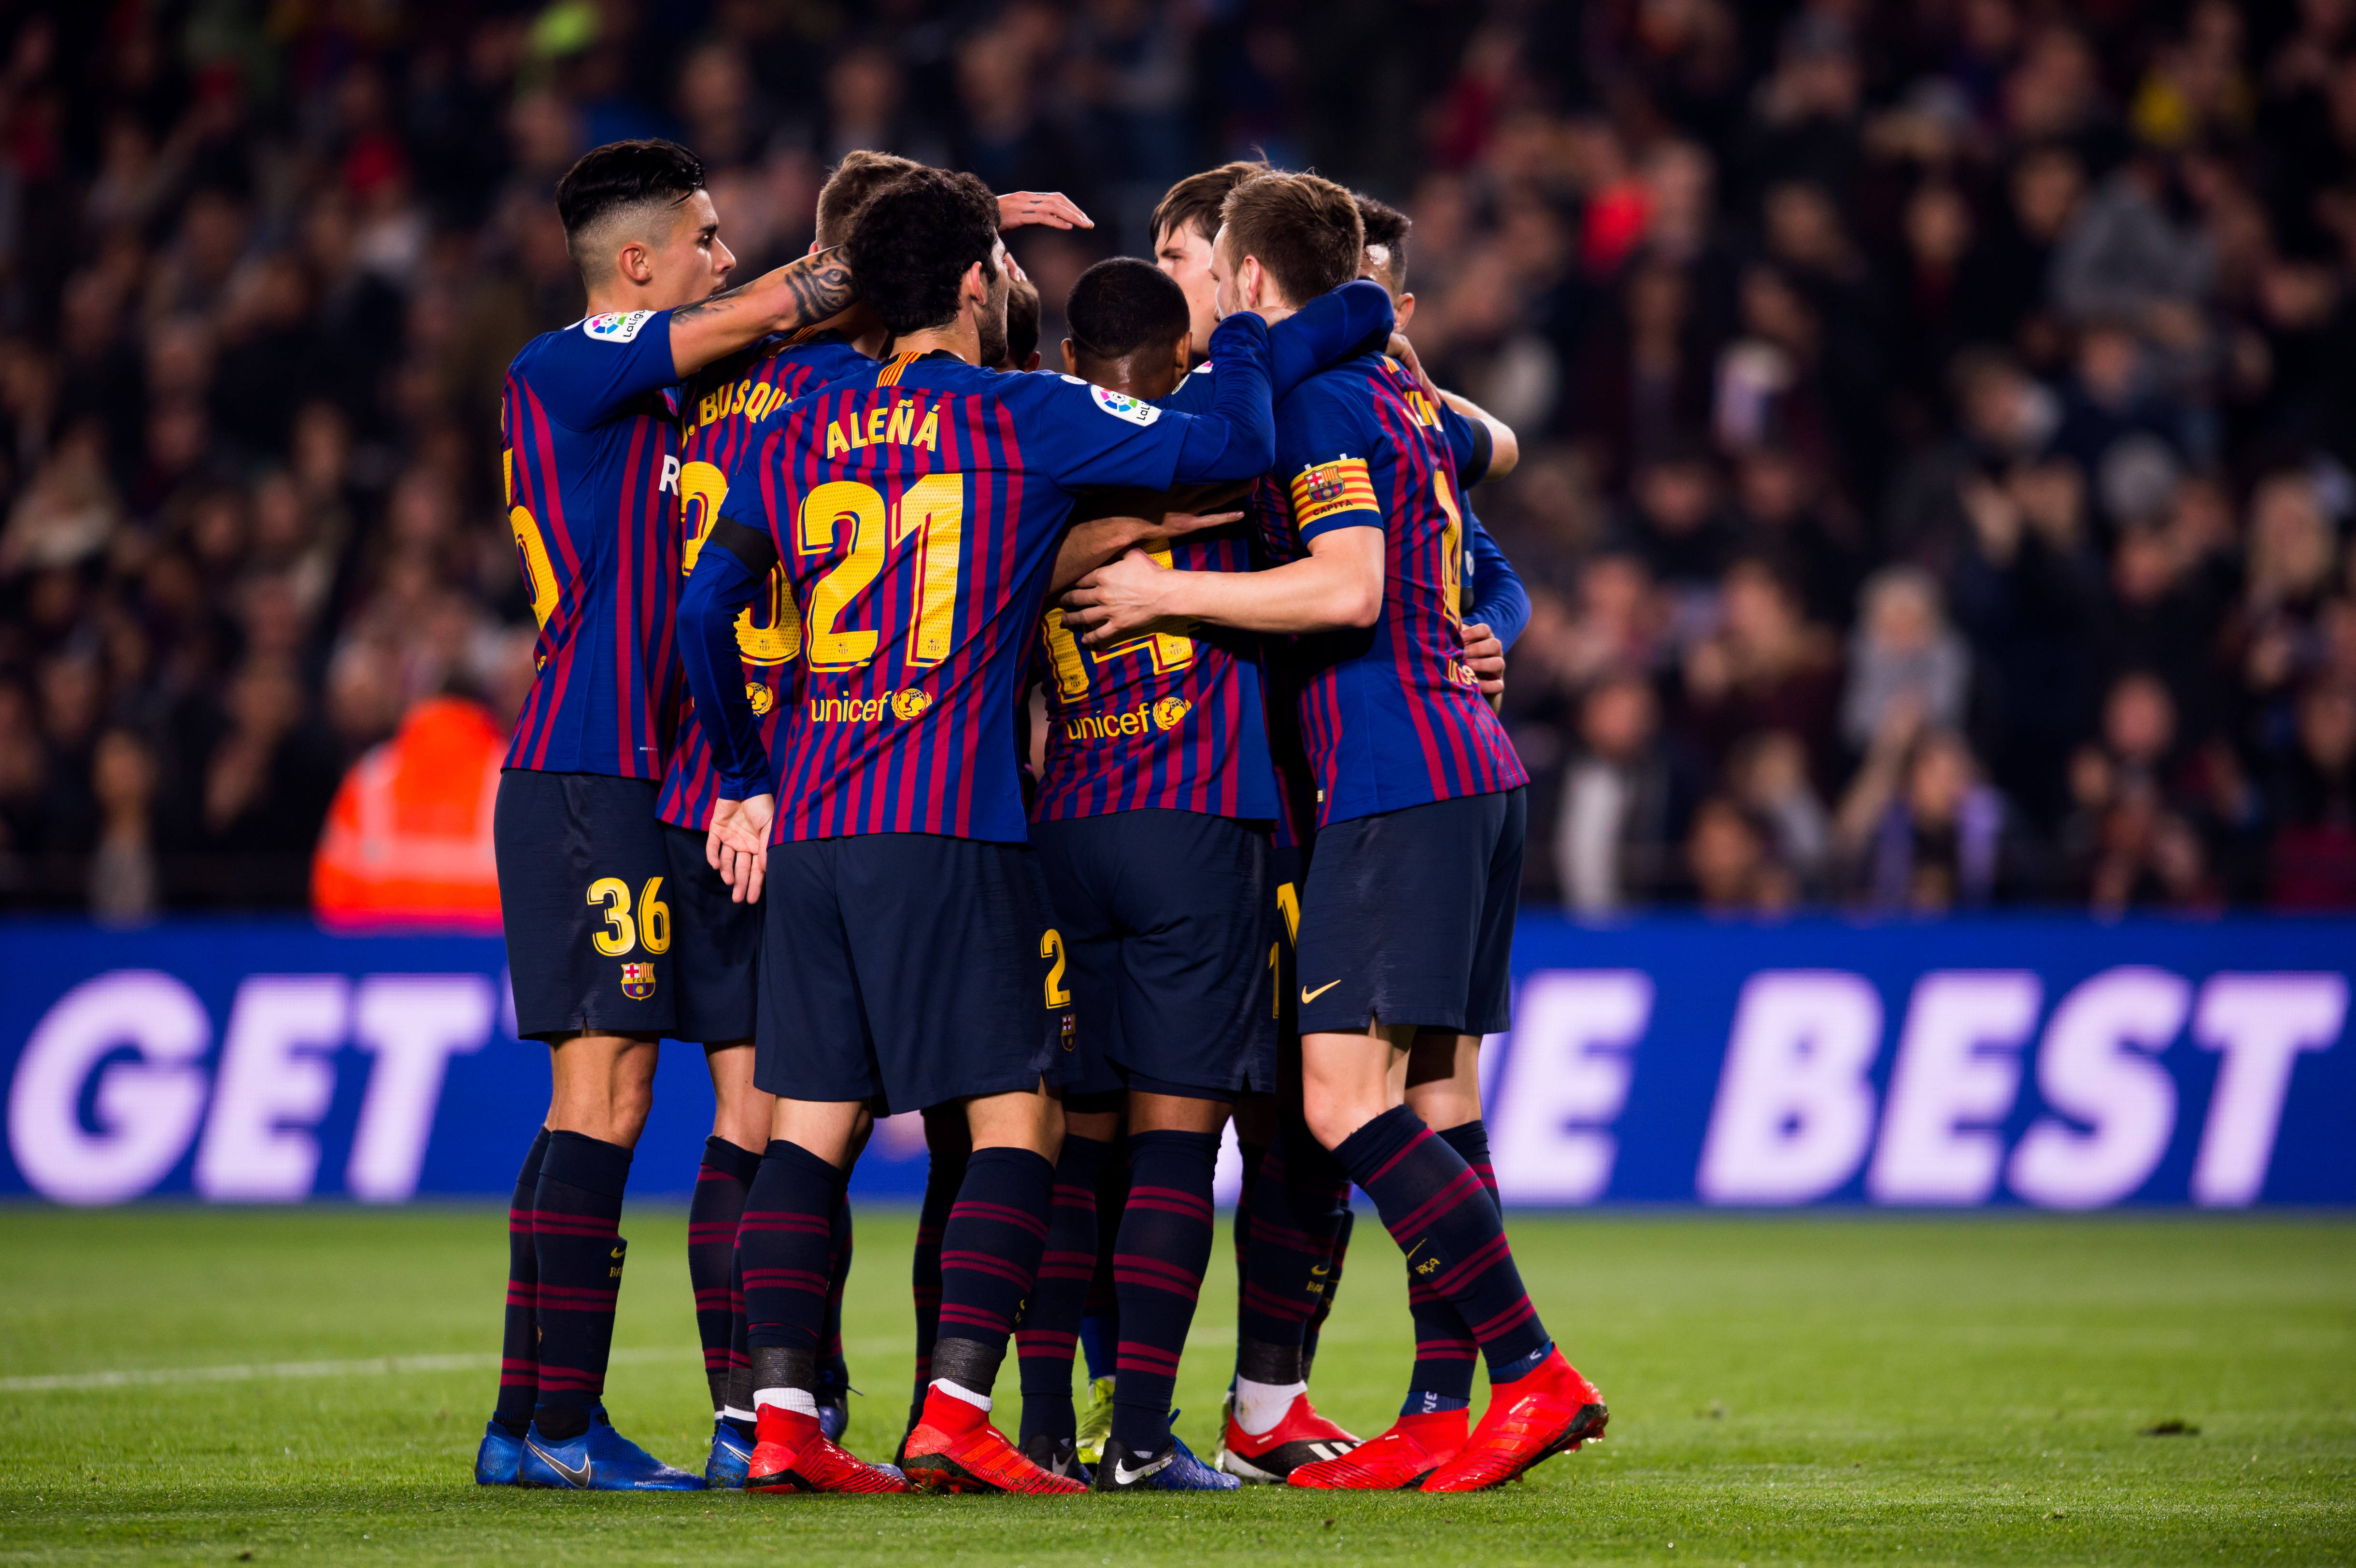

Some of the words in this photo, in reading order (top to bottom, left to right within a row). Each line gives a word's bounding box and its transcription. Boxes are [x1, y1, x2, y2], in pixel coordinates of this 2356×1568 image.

[826, 399, 940, 459] ALEÑÁ
[1317, 481, 1332, 490] FCB
[798, 473, 963, 673] 21
[811, 691, 892, 722] unicef
[1063, 703, 1150, 740] unicef
[586, 876, 671, 956] 36
[1040, 929, 1070, 1009] 2
[7, 967, 519, 1206] GET
[1695, 966, 2350, 1209] BEST
